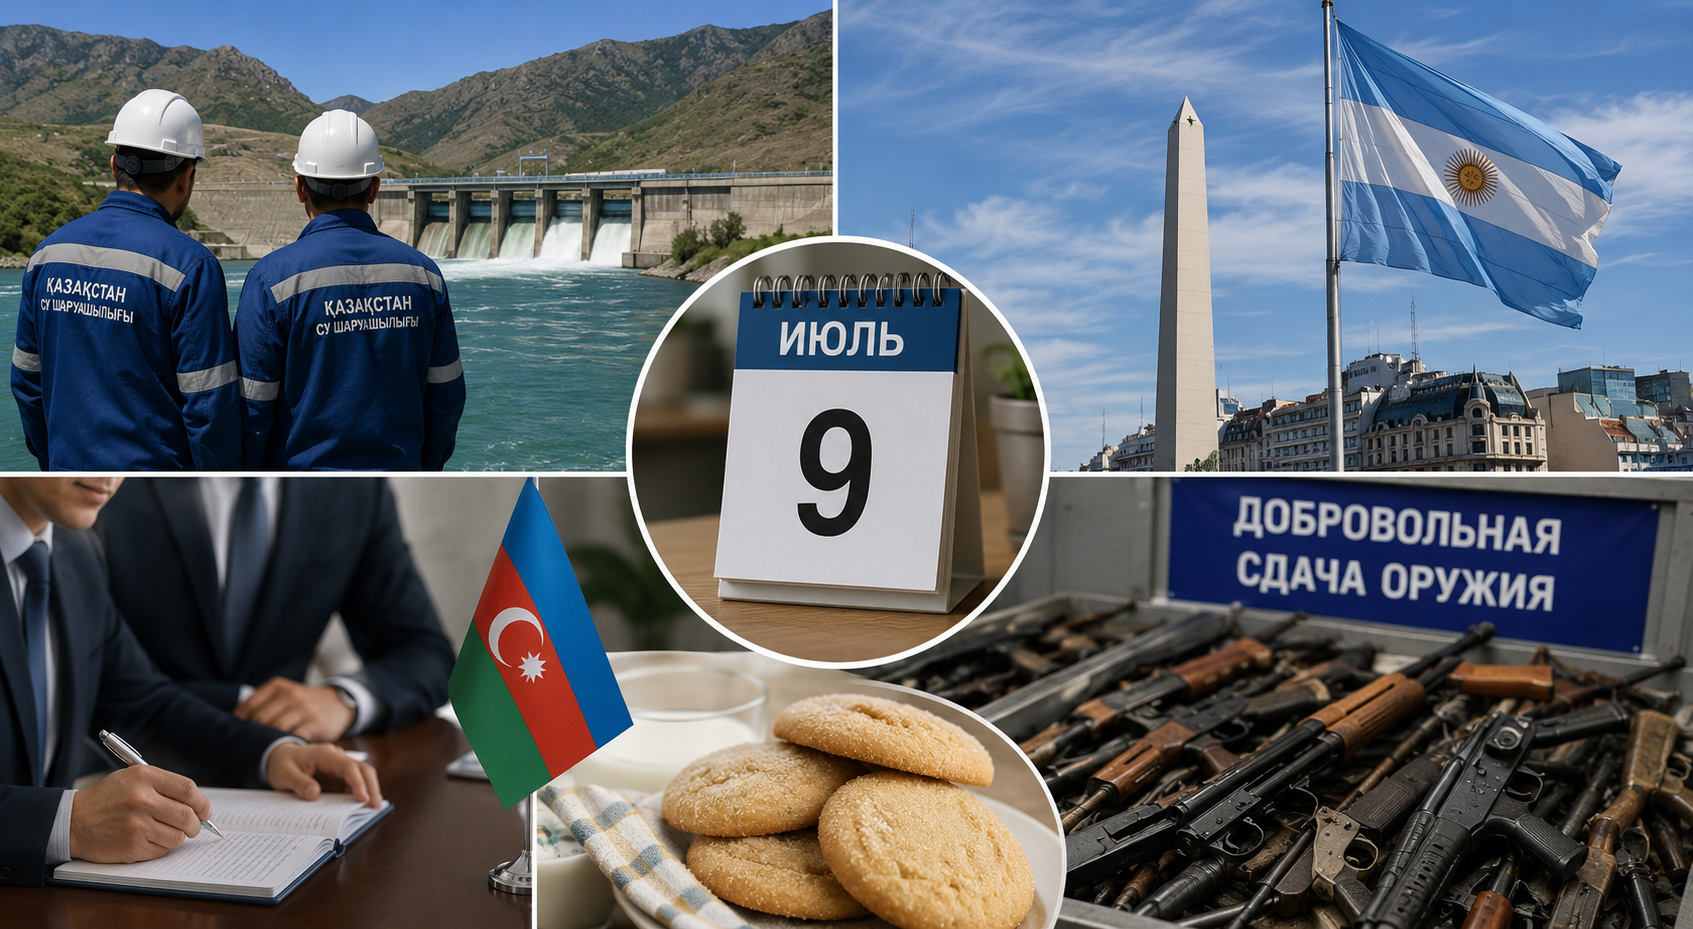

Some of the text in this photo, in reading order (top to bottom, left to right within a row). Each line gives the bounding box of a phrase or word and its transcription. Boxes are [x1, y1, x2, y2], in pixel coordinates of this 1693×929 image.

[46, 277, 127, 303] ҚАЗАҚСТАН
[324, 295, 412, 318] ҚАЗАҚСТАН
[316, 322, 331, 336] СУ
[779, 320, 904, 357] ИЮЛЬ
[797, 408, 873, 537] 9
[1233, 495, 1562, 555] ДОБРОВОЛЬНАЯ
[1236, 550, 1556, 612] СДАЧА ОРУЖИЯ
